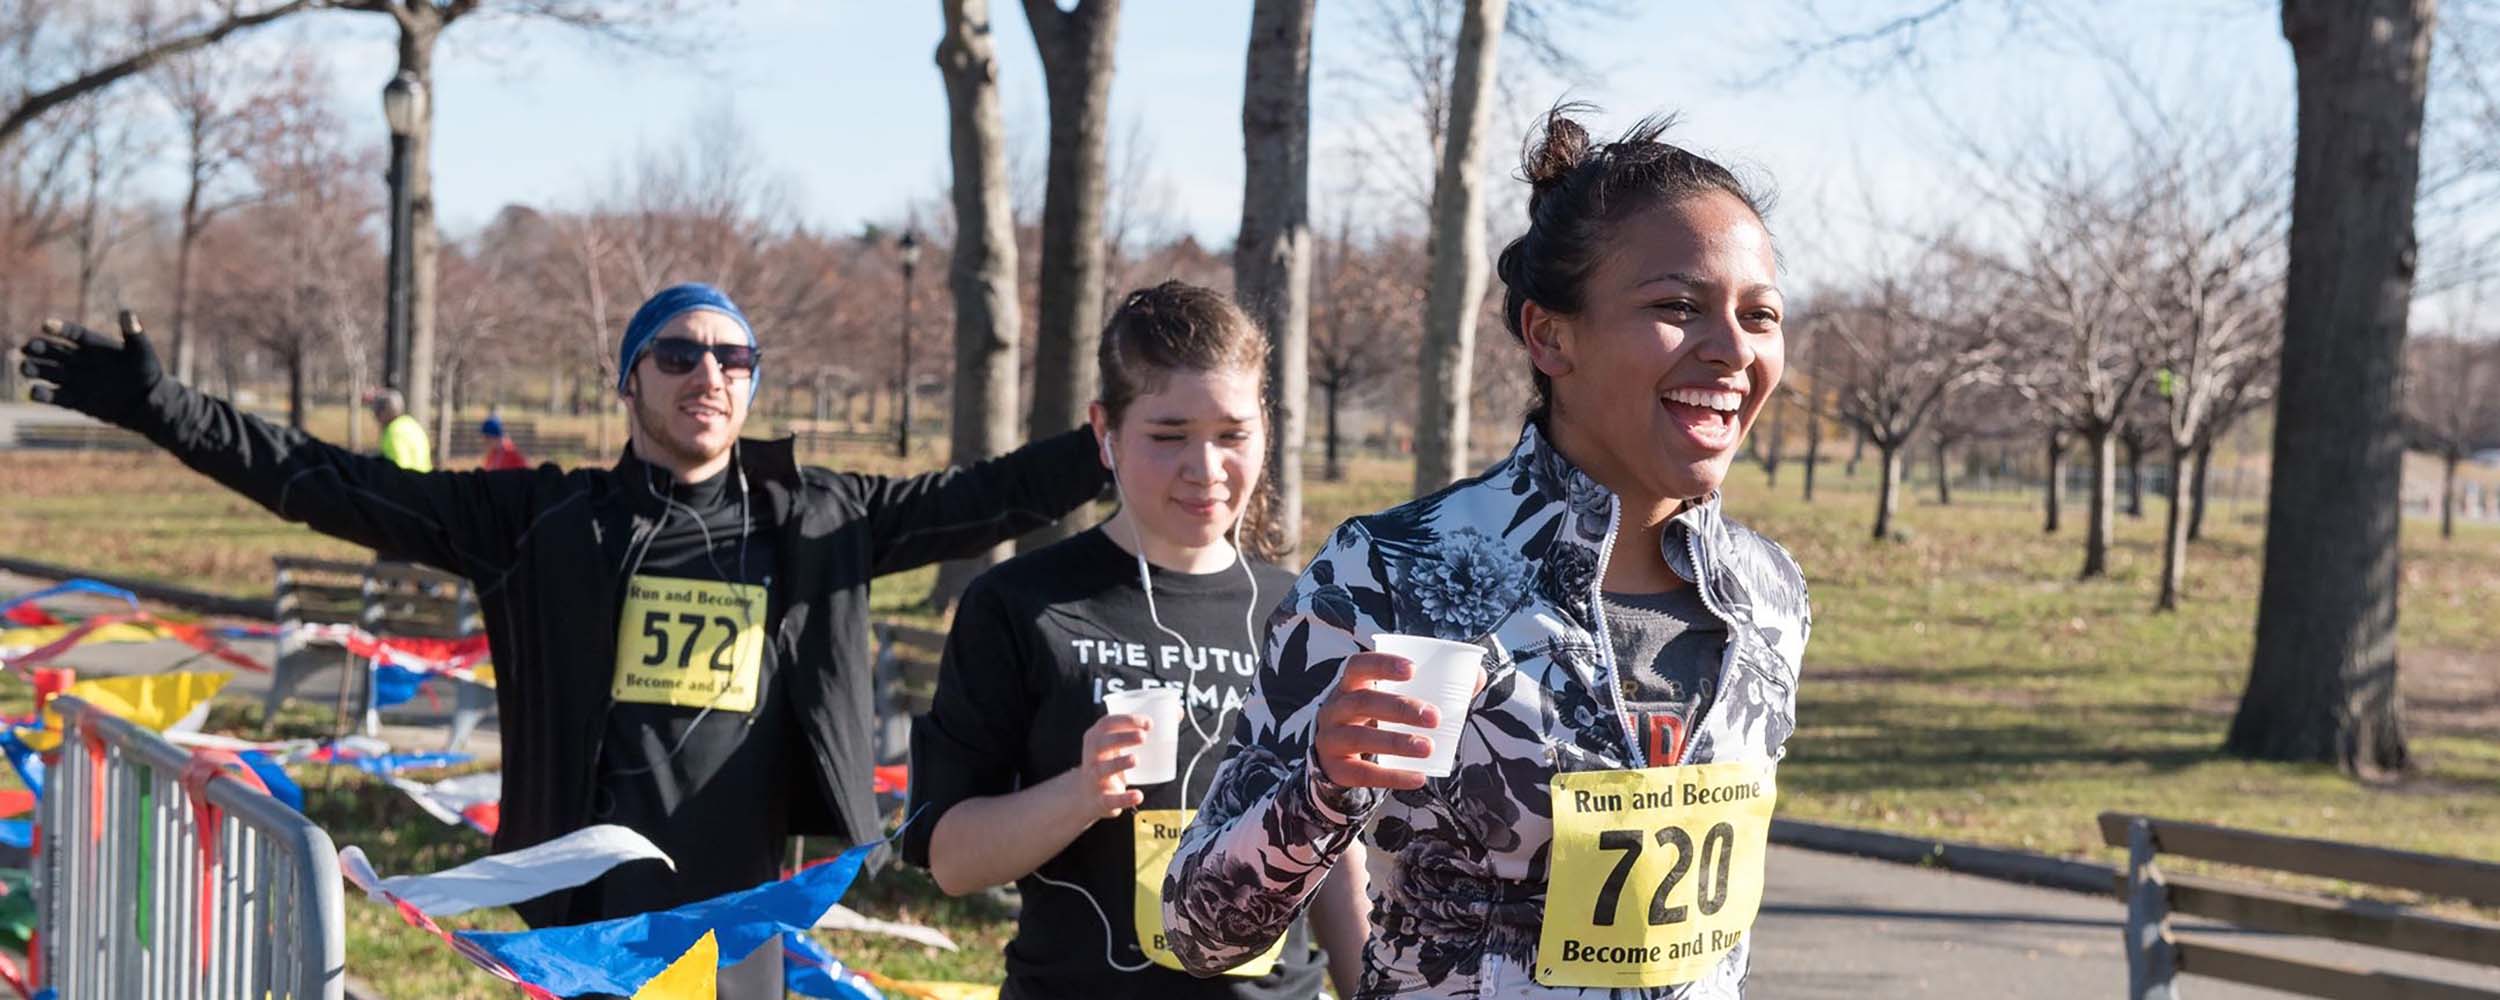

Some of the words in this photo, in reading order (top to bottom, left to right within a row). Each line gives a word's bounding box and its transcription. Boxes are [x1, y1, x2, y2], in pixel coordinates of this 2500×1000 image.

[630, 586, 660, 600] Run
[665, 590, 692, 603] and
[642, 610, 738, 672] 572
[1071, 639, 1148, 667] THE
[626, 673, 683, 689] Become
[688, 679, 715, 692] and
[1574, 790, 1622, 813] Run
[1632, 785, 1673, 810] and
[1682, 781, 1760, 807] Become
[1153, 823, 1181, 839] Ru
[1592, 821, 1735, 927] 720
[1562, 939, 1660, 964] Become
[1668, 933, 1703, 960] and
[1711, 929, 1741, 952] Run
